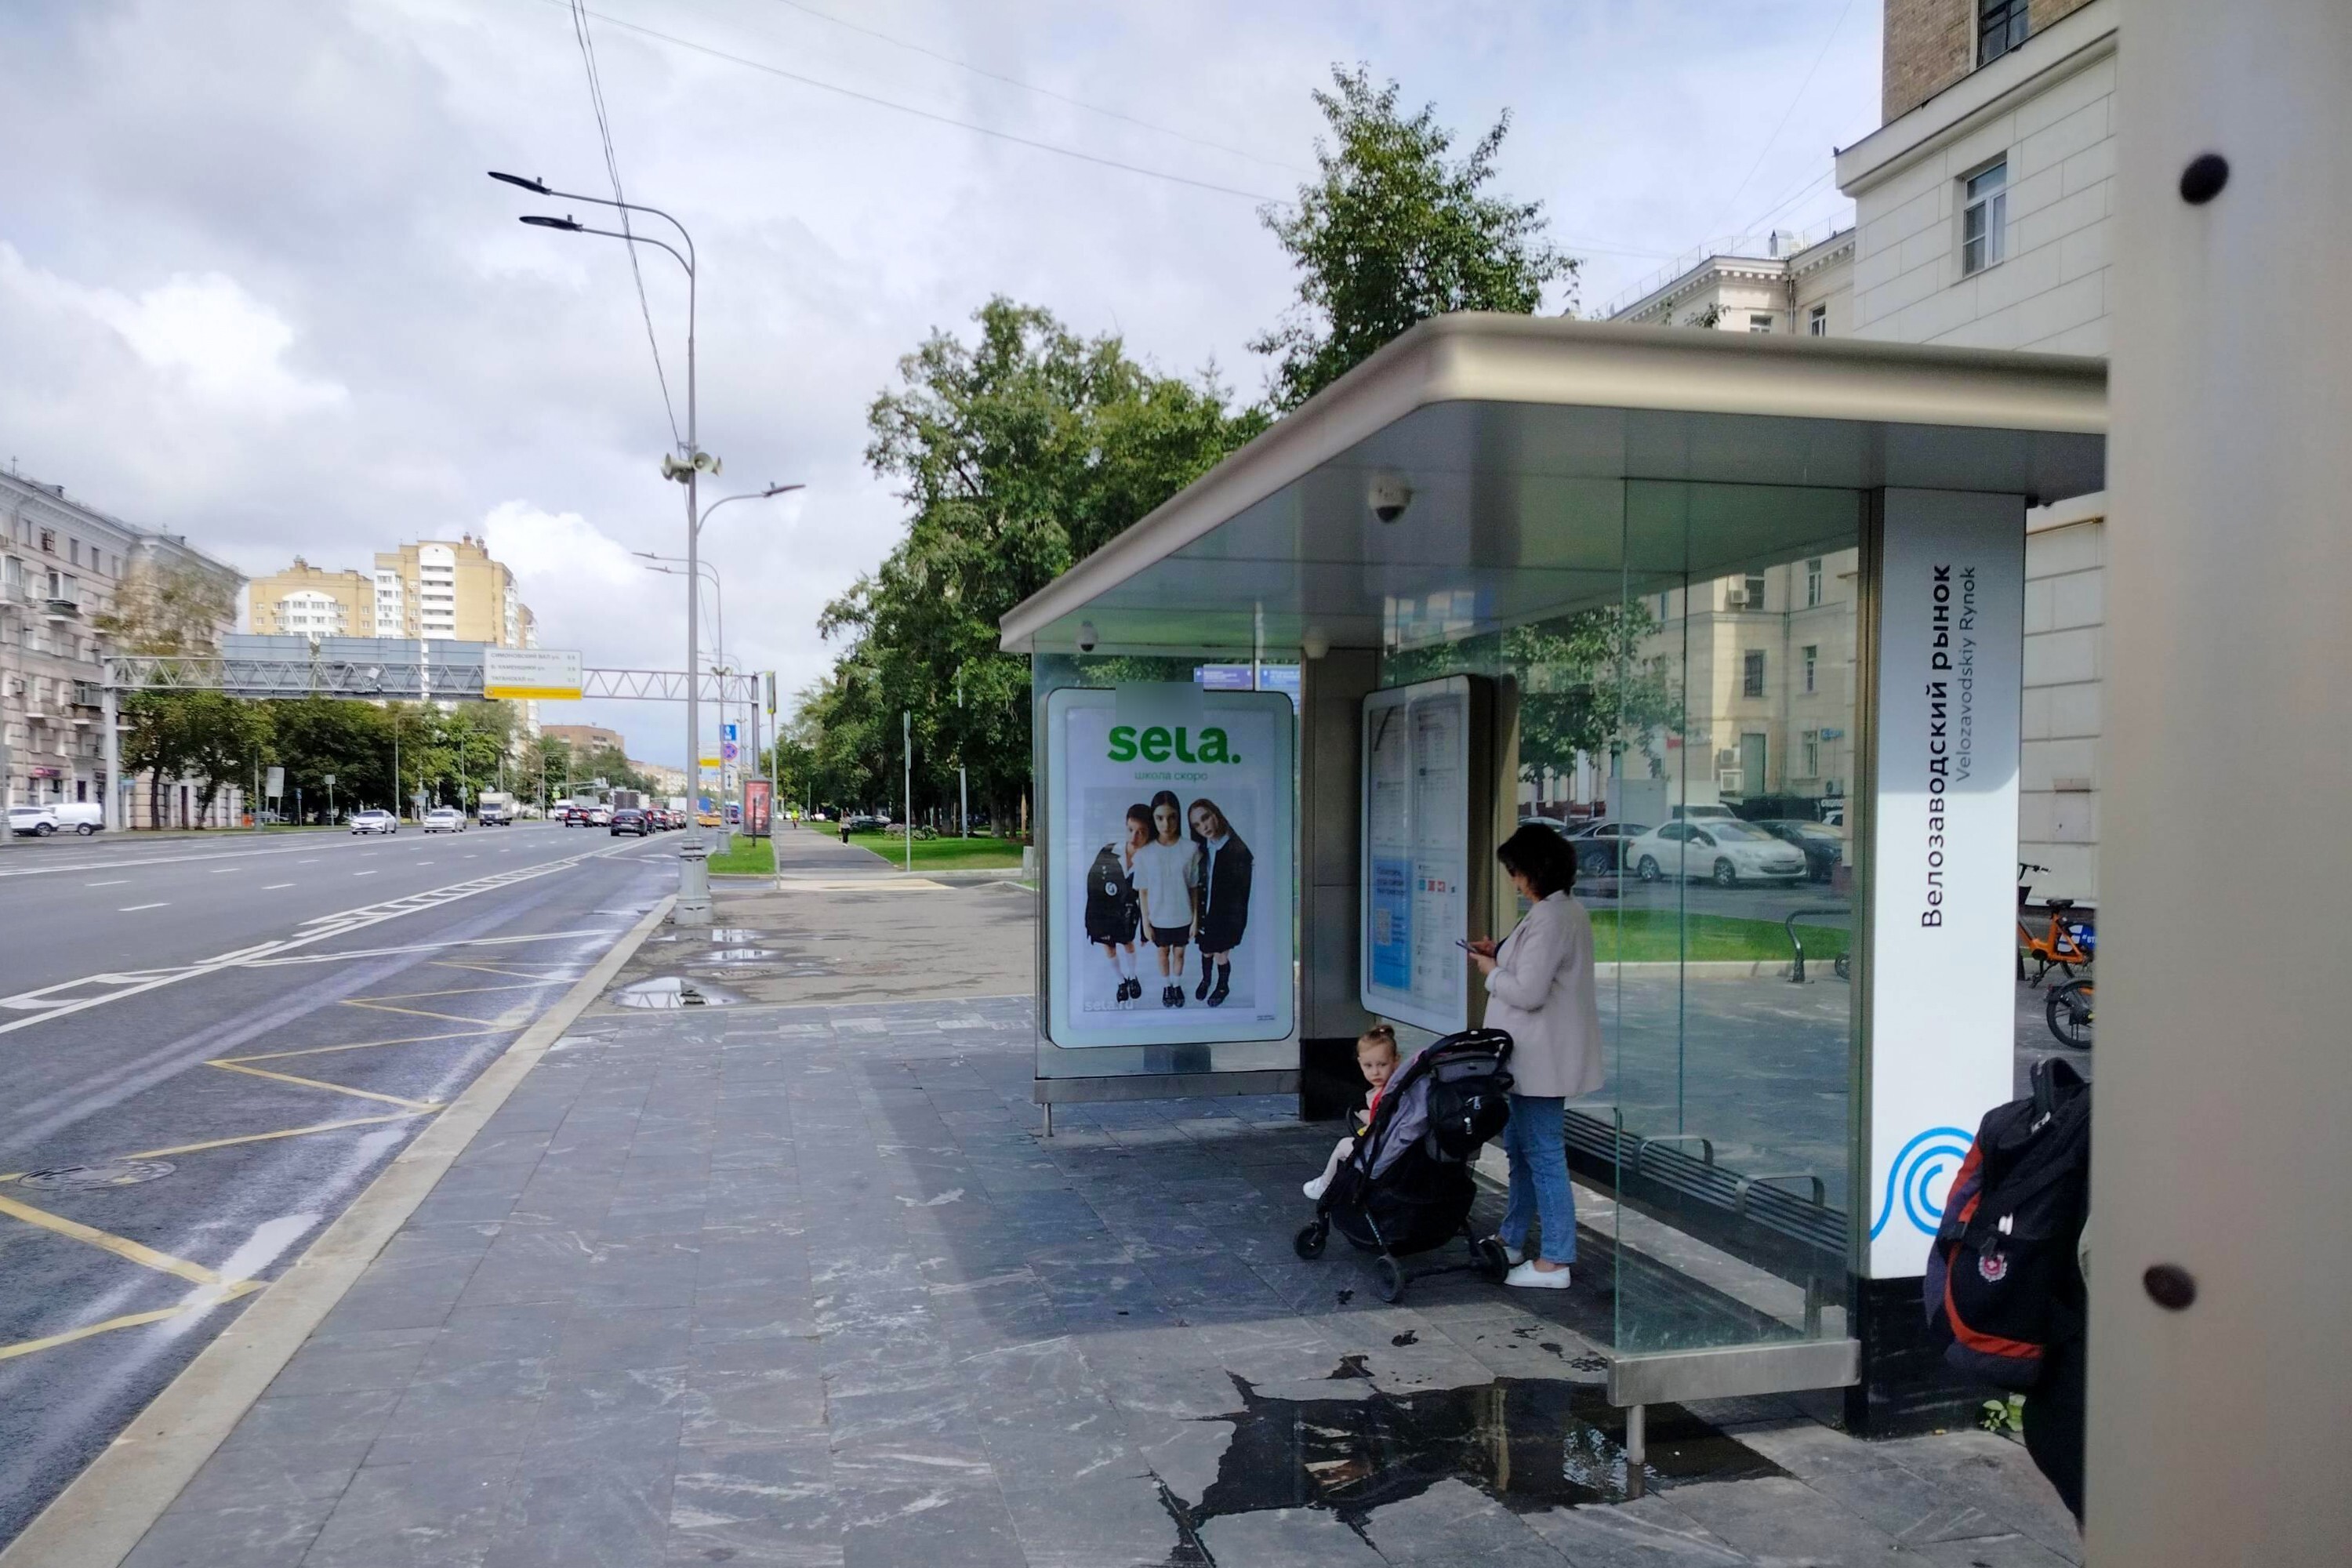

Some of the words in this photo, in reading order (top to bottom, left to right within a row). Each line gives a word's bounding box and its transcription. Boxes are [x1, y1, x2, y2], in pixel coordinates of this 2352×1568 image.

[1932, 564, 1953, 670] рынок
[1959, 566, 1977, 630] Rynok
[1956, 637, 1976, 782] Velozavodskiy
[1107, 725, 1242, 764] sela.
[1134, 771, 1171, 781] школа
[1174, 771, 1208, 782] скоро
[1922, 682, 1949, 927] Велозаводский
[1084, 1000, 1134, 1012] sela.ru
